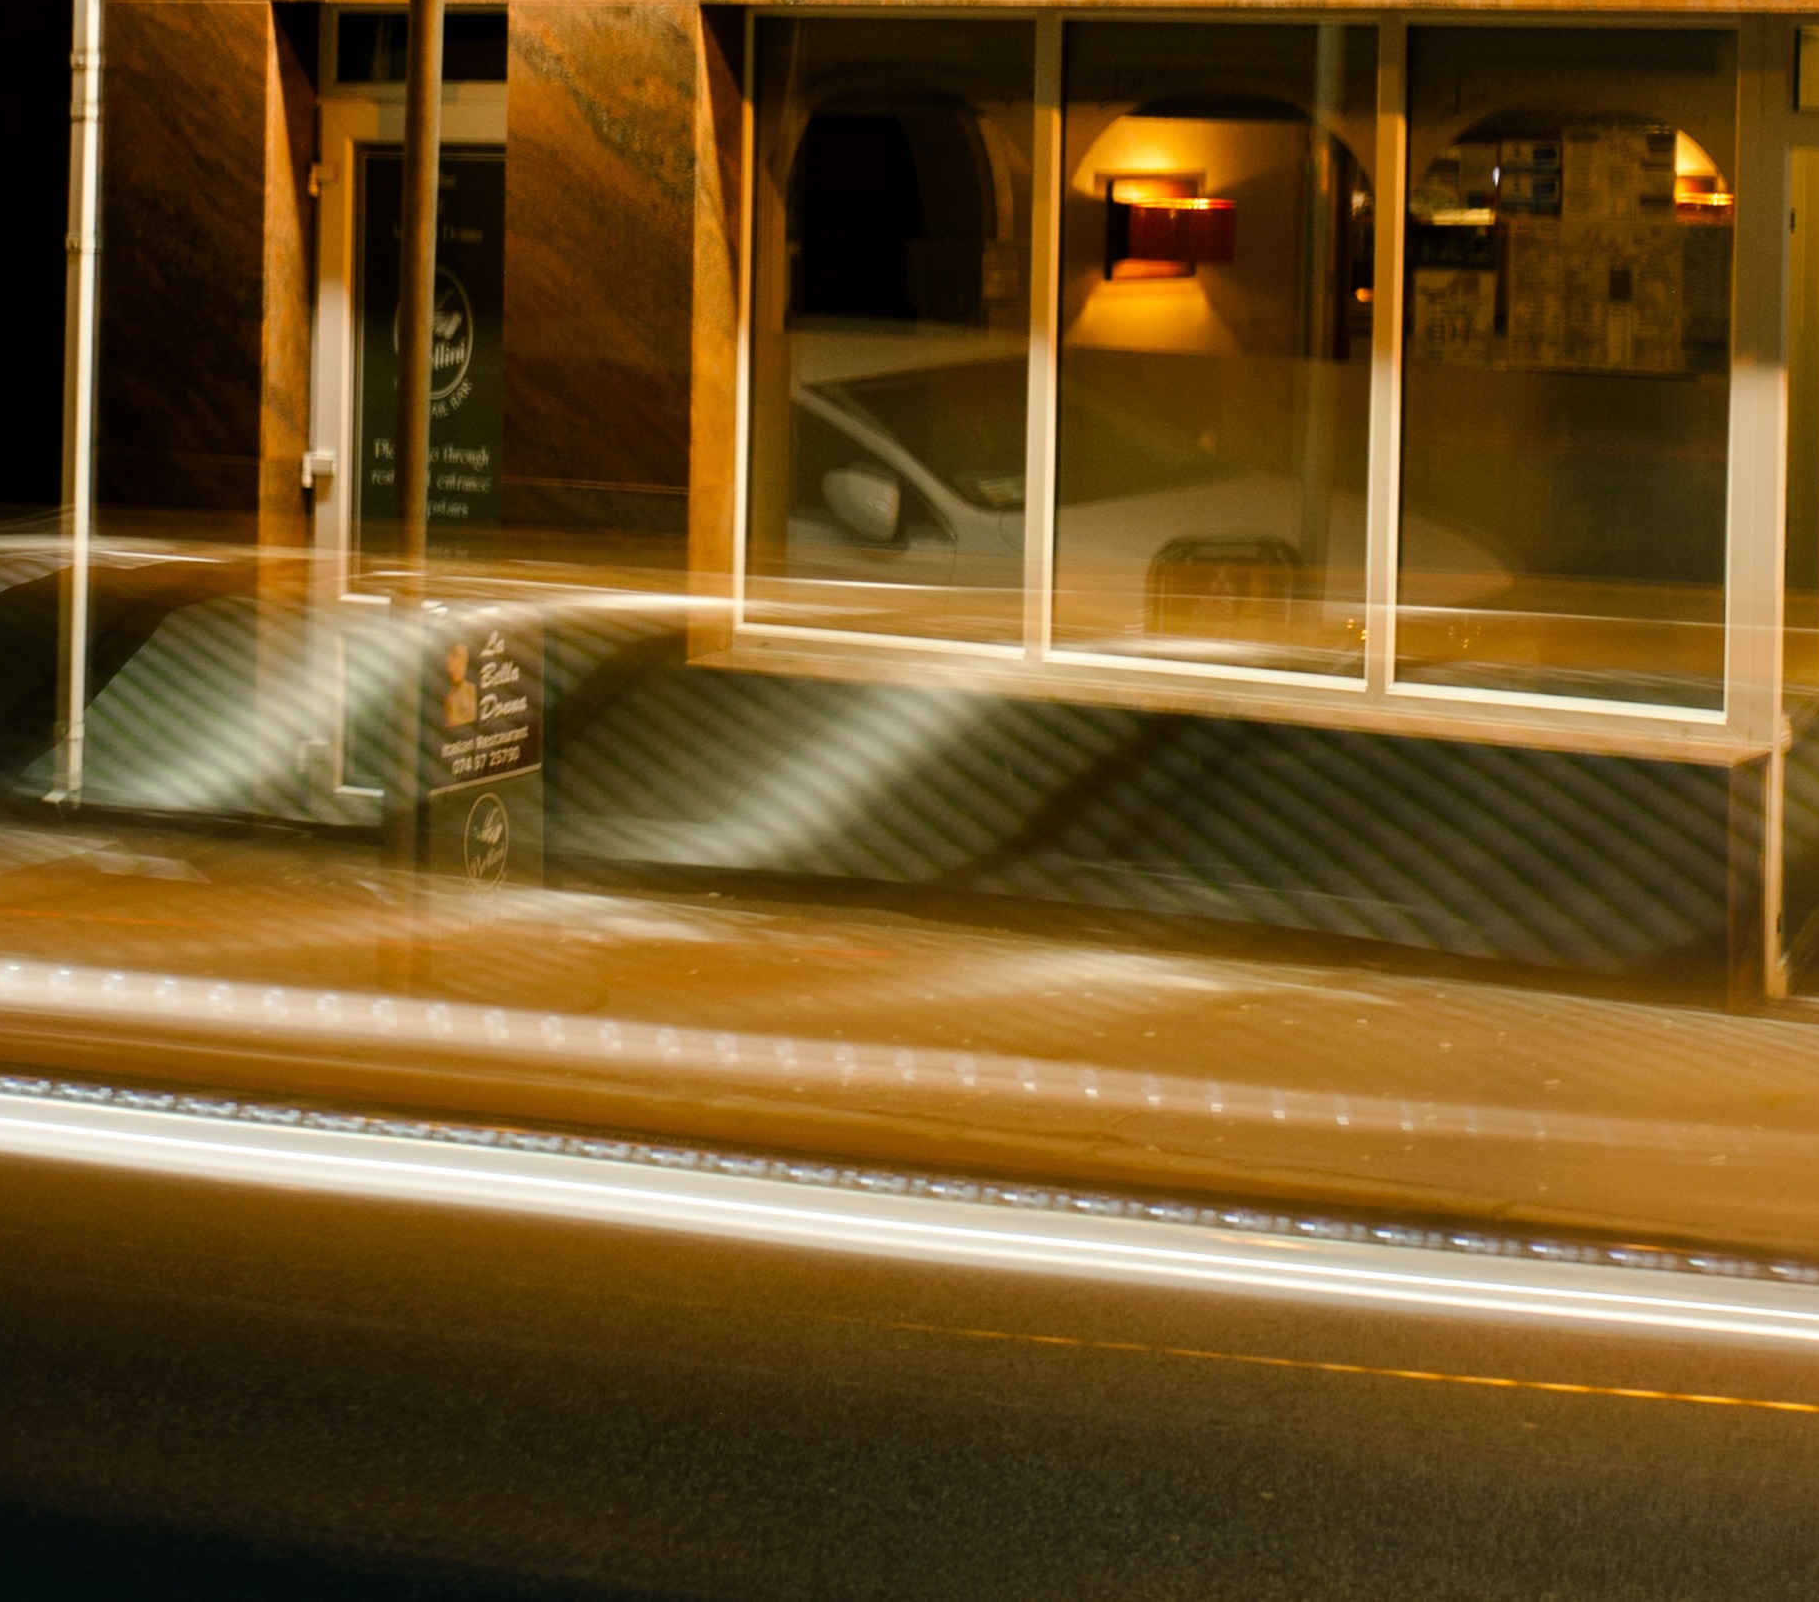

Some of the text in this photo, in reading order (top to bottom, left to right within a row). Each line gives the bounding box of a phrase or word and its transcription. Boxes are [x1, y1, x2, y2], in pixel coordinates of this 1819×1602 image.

[443, 443, 489, 471] through
[436, 474, 492, 493] entrance
[479, 630, 505, 658] La
[479, 661, 521, 689] Bella
[479, 693, 528, 722] Donna
